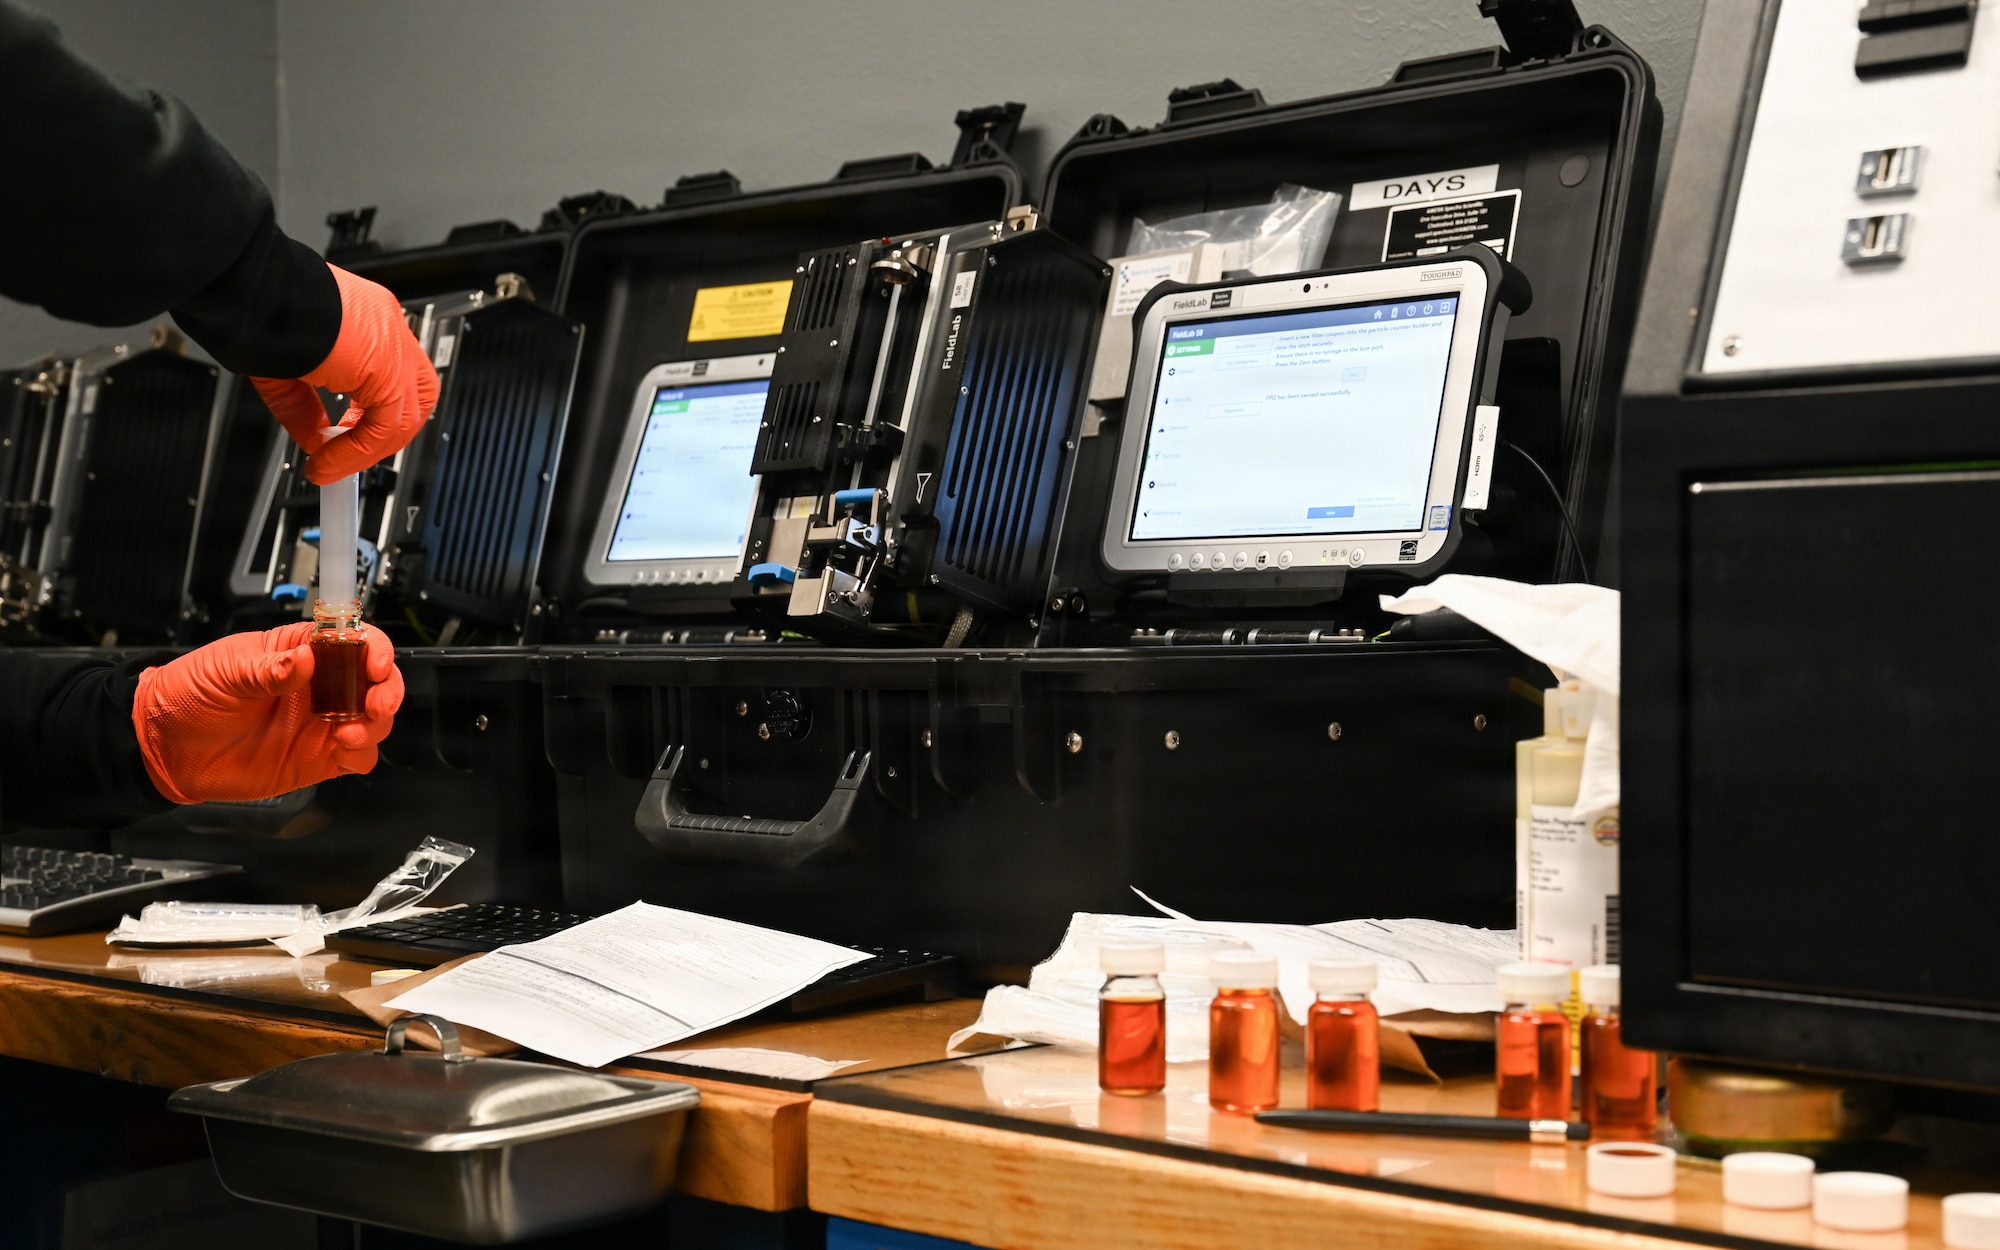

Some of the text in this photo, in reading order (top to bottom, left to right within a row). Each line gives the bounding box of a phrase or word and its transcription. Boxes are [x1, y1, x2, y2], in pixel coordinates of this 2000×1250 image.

[1383, 175, 1466, 199] DAYS
[1423, 270, 1460, 279] TOUGHPAD
[742, 287, 774, 298] CAUTION
[955, 285, 962, 296] 58
[1173, 298, 1207, 310] FieldLab
[1368, 326, 1389, 334] particle
[1412, 321, 1430, 329] holder
[1431, 319, 1443, 327] and
[1172, 329, 1195, 339] FieldLab
[942, 314, 962, 369] FieldLab
